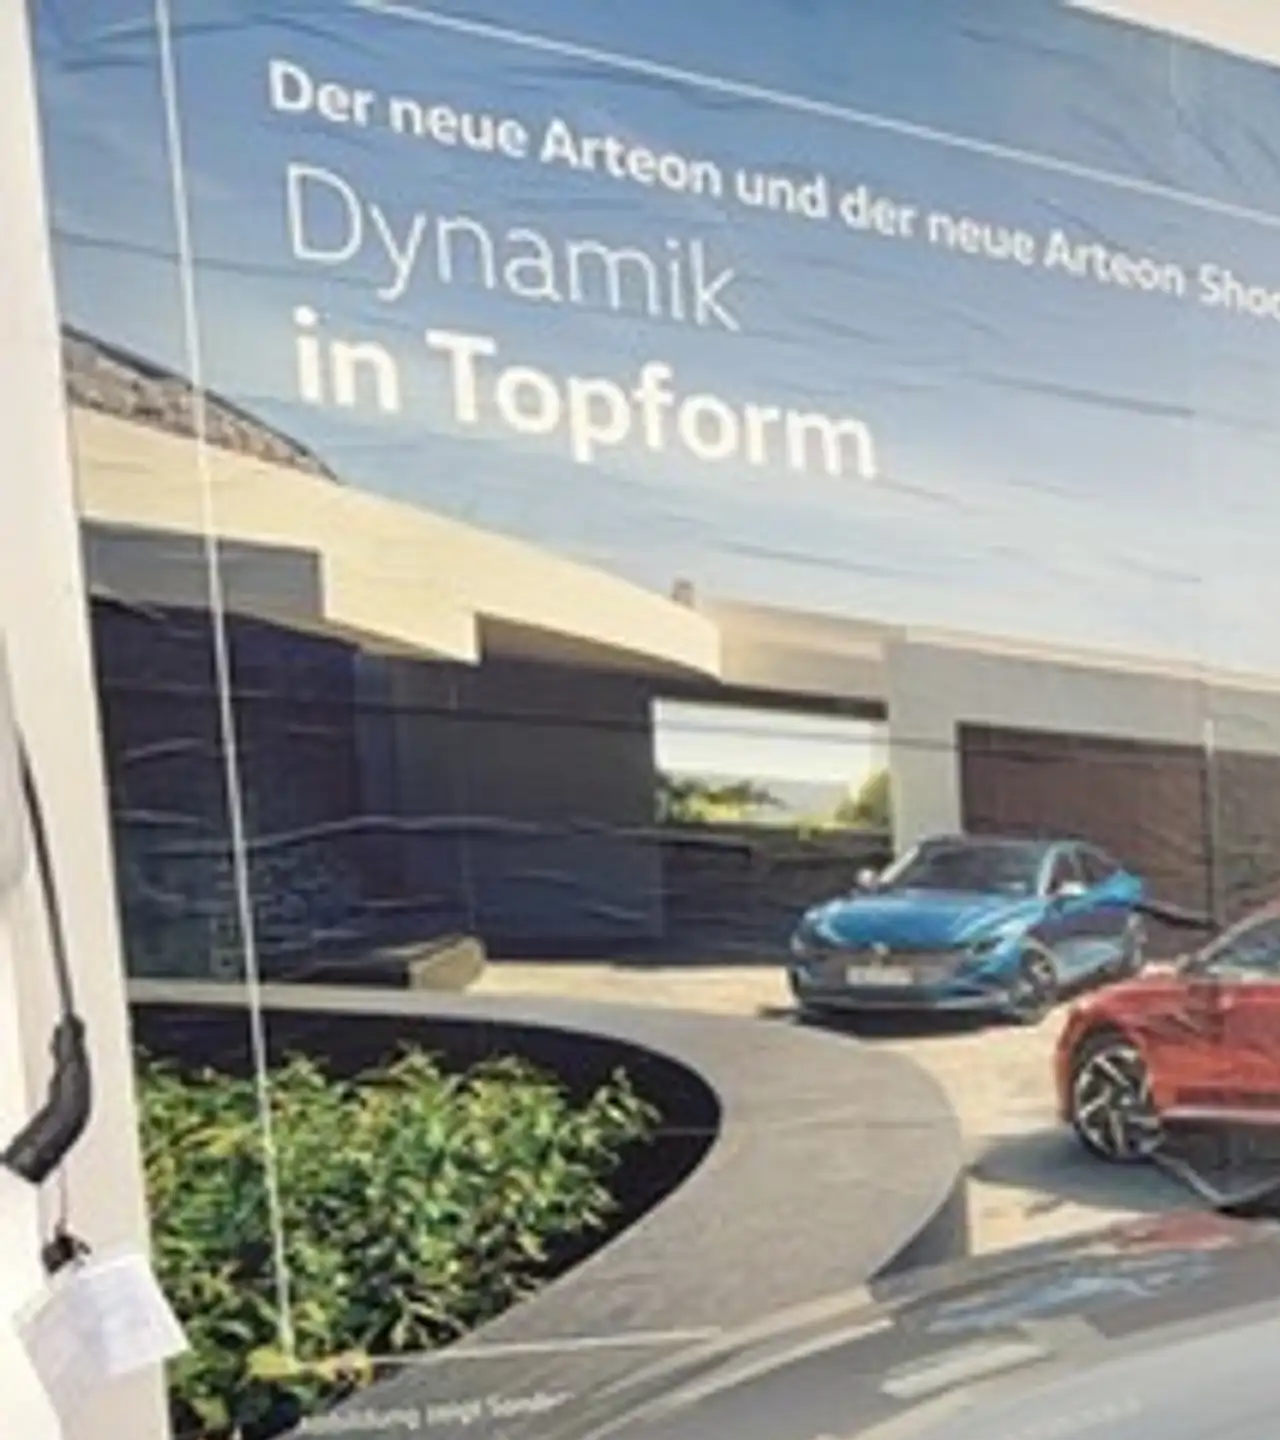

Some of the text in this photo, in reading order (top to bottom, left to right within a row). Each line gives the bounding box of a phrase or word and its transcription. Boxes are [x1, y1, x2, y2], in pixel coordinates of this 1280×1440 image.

[268, 58, 375, 125] Der
[389, 97, 529, 158] neue
[540, 117, 722, 196] Arteon
[735, 171, 829, 221] und
[838, 181, 916, 239] der
[927, 209, 1035, 268] neue
[1043, 227, 1186, 298] Arteon
[283, 161, 742, 334] Dynamik
[290, 304, 877, 481] in Topform
